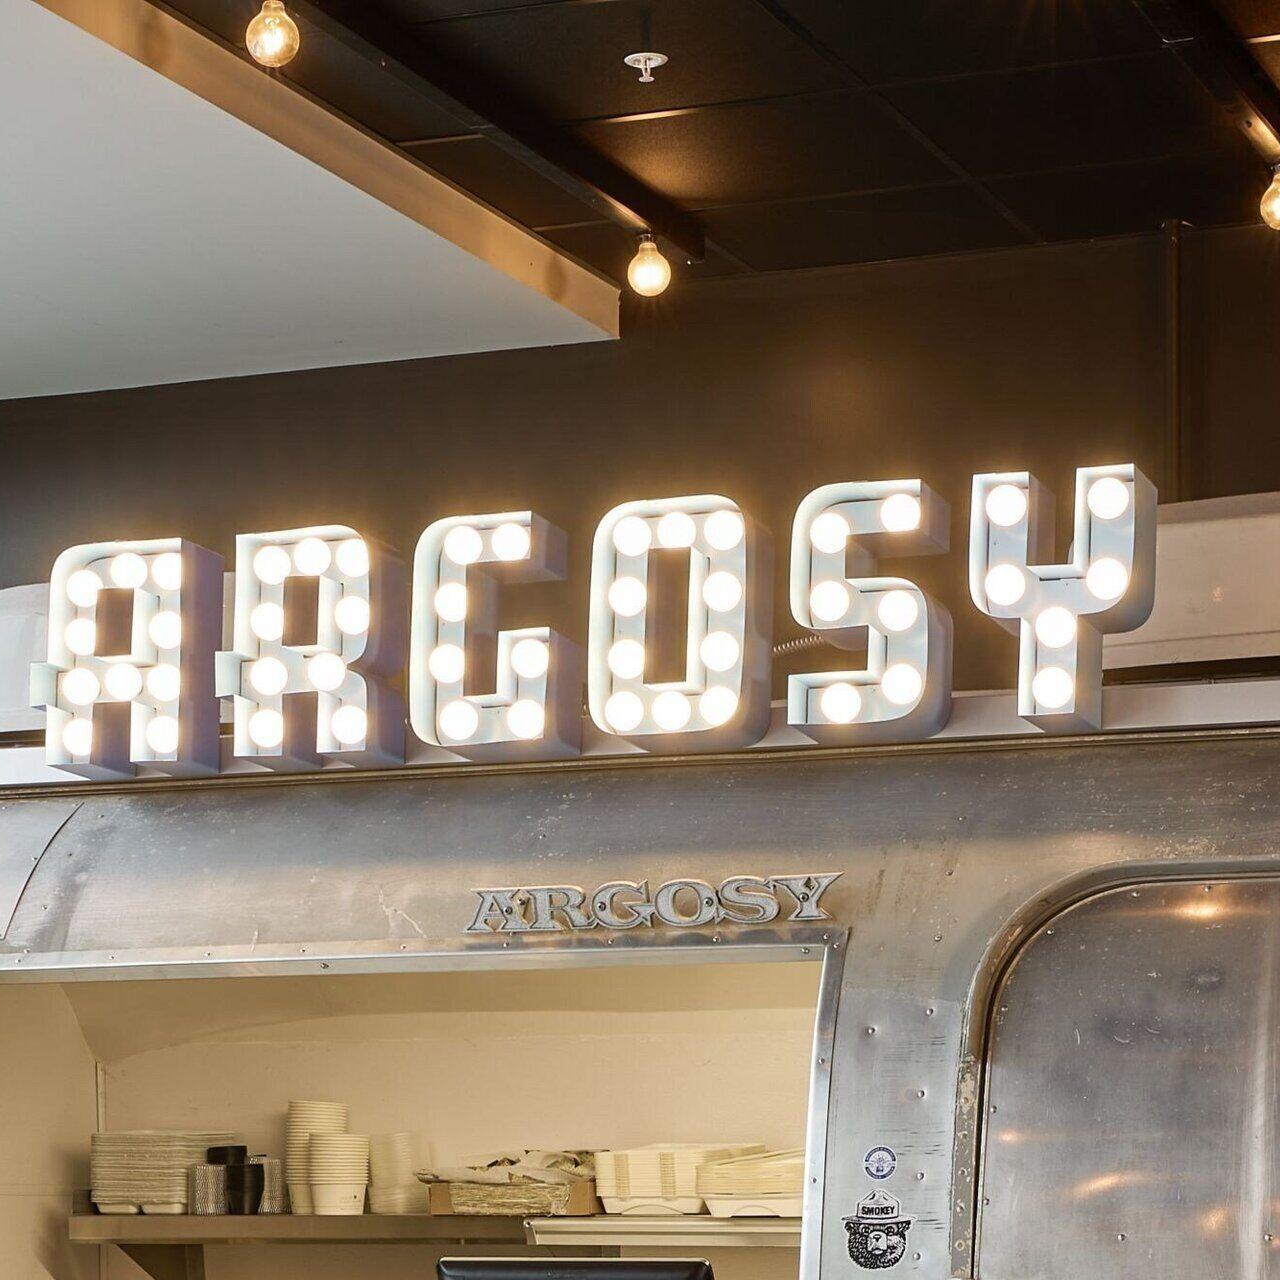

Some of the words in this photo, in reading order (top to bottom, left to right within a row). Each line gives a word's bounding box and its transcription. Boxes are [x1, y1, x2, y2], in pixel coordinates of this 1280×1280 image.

[30, 463, 1158, 778] ARGOSY
[467, 872, 844, 932] ARGOSY
[861, 1206, 896, 1216] SMOKEY
